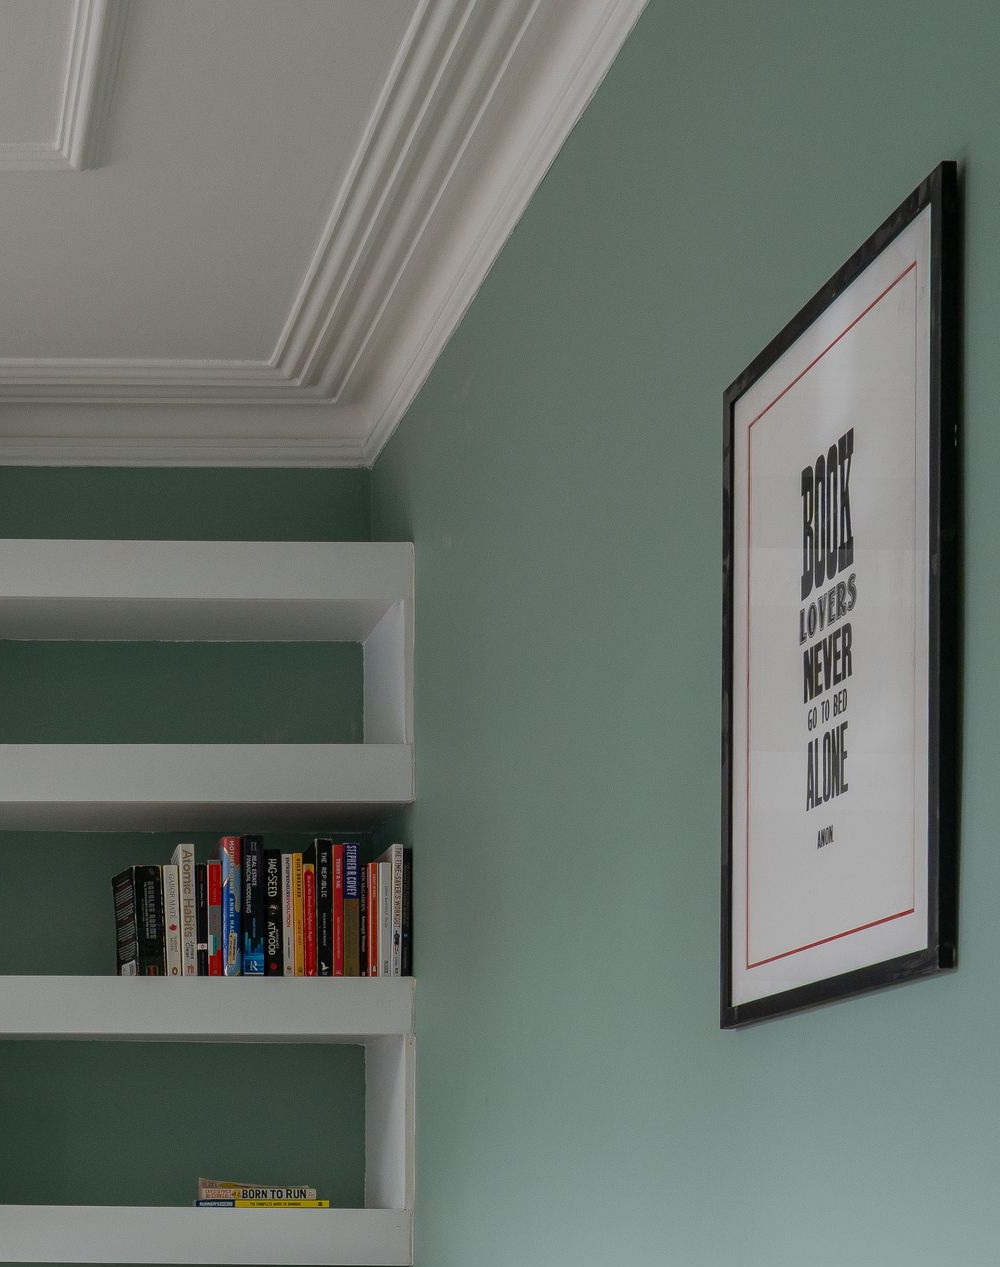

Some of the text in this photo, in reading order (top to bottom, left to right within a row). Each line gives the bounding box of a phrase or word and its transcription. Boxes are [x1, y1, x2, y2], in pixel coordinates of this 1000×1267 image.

[801, 427, 854, 601] BOOK
[799, 572, 857, 646] LOVERS
[803, 622, 853, 705] NEVER
[807, 688, 848, 731] GO TO BED
[806, 720, 849, 812] ALONE
[267, 858, 278, 898] HAG-SEED
[346, 844, 357, 870] STEPHEN
[182, 849, 195, 938] Atomic Habits
[346, 876, 357, 896] COVEY
[267, 921, 276, 956] ATWOOD
[242, 1189, 267, 1199] BORN
[271, 1189, 283, 1199] TO
[286, 1189, 307, 1199] RUN
